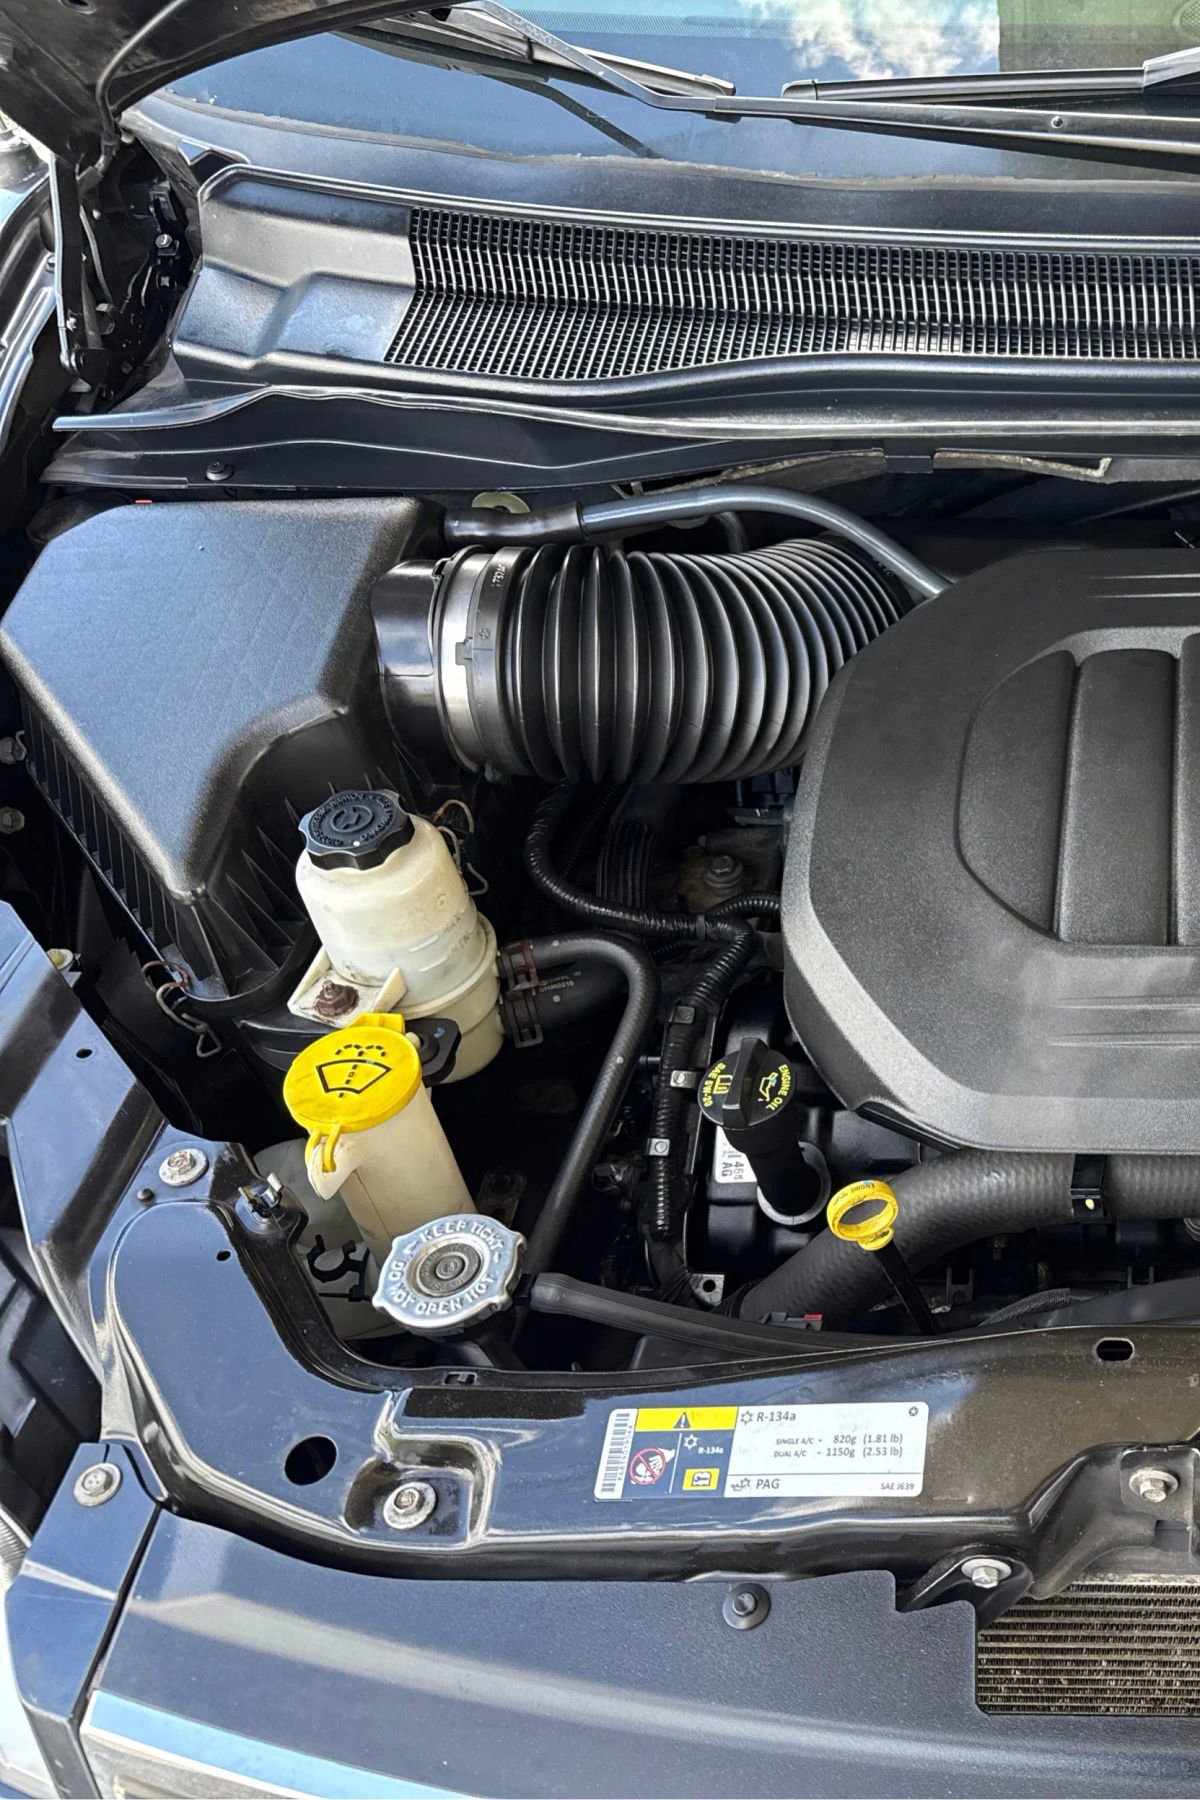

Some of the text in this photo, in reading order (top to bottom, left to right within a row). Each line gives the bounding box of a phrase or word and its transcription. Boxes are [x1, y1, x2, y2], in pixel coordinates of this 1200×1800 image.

[707, 1062, 727, 1080] SAE
[765, 1064, 791, 1111] ENGINE OIL
[722, 1161, 733, 1178] AG
[419, 1220, 467, 1243] KEEP
[388, 1260, 406, 1281] DO
[415, 1298, 464, 1315] OPEN
[756, 1410, 797, 1422] R-134a
[775, 1437, 800, 1446] SINGLE
[801, 1437, 815, 1446] A/C
[833, 1434, 857, 1446] 820g
[862, 1433, 888, 1445] (1.81
[889, 1433, 904, 1444] lb)
[698, 1446, 725, 1455] R-134a
[773, 1450, 792, 1459] DUAL
[793, 1449, 808, 1458] A/C
[826, 1446, 856, 1458] 1150g
[862, 1446, 888, 1458] (2.53
[889, 1446, 904, 1457] lb)
[756, 1478, 781, 1490] PAG
[880, 1481, 916, 1491] SAE J639
